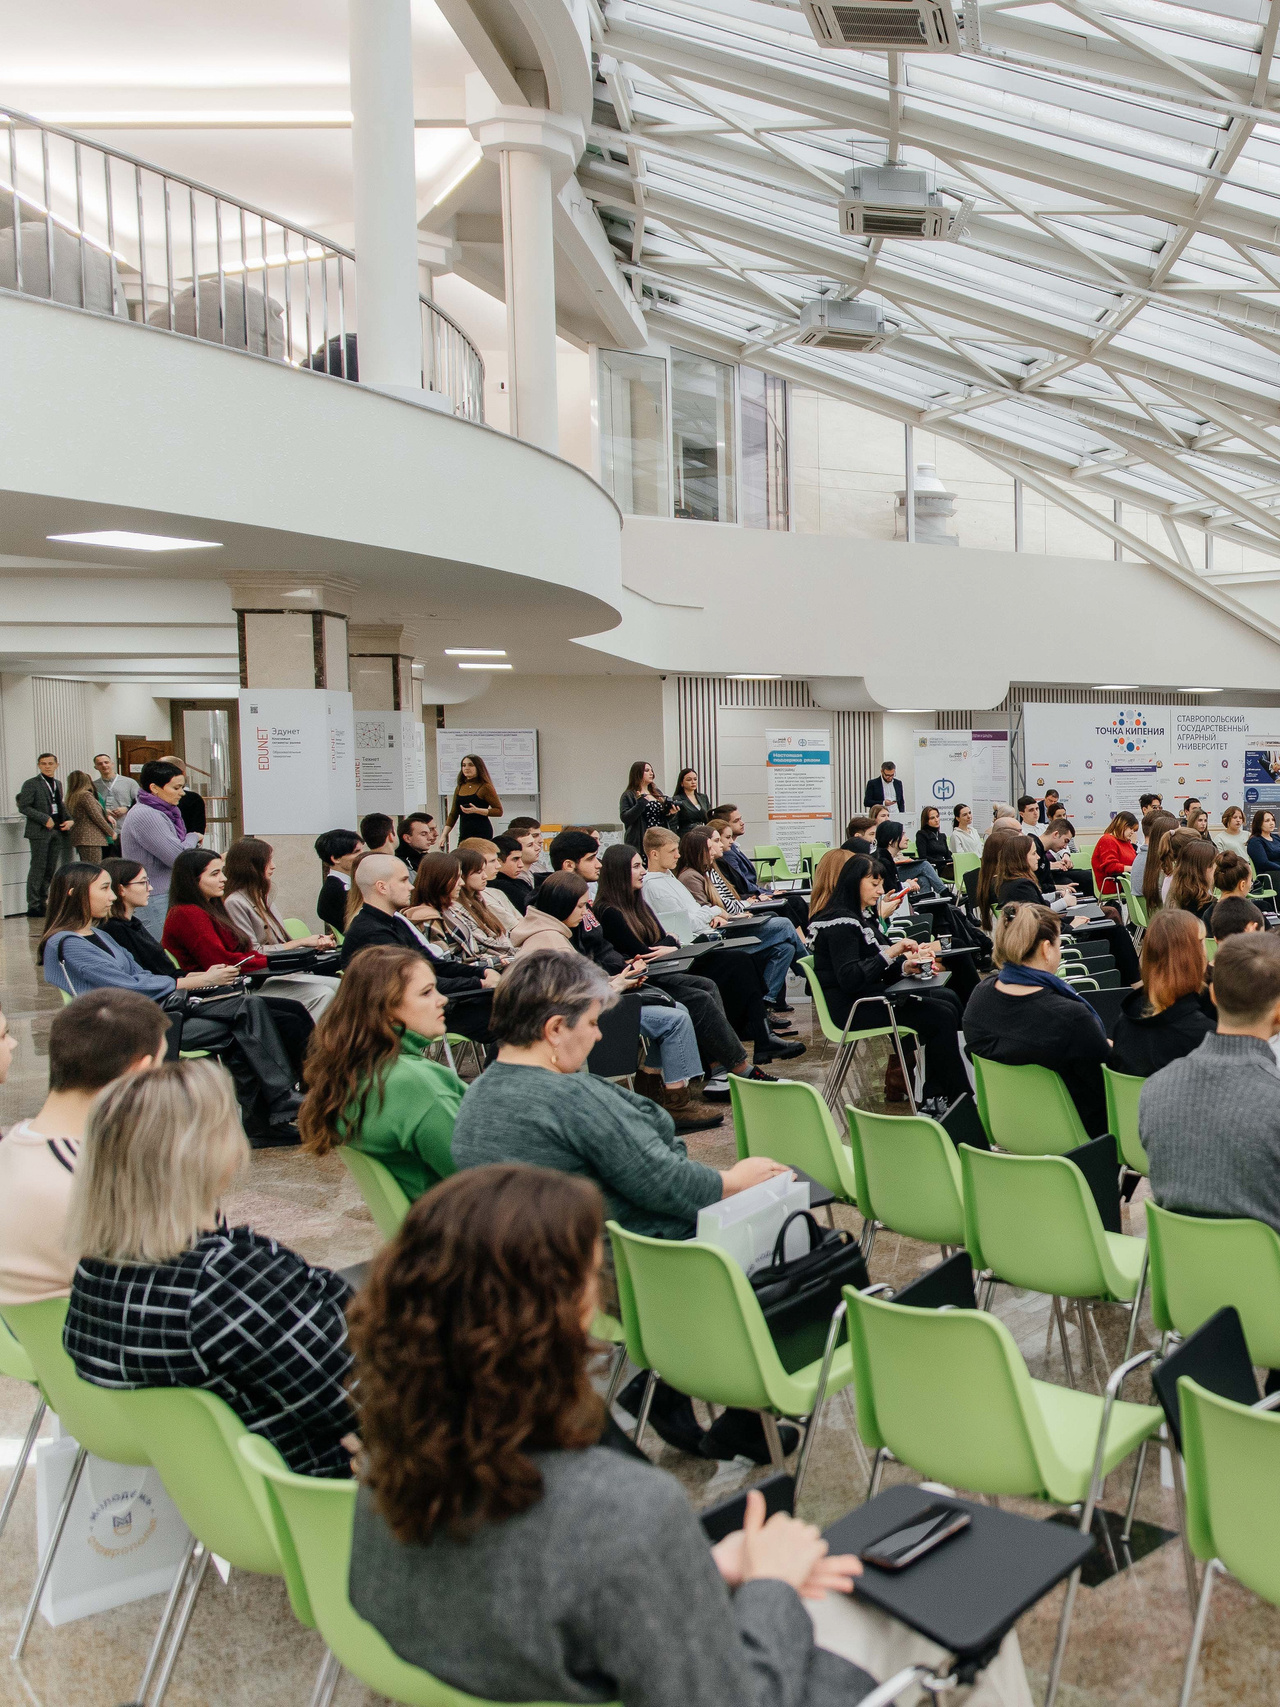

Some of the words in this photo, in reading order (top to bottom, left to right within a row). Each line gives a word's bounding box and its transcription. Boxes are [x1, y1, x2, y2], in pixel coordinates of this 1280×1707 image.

[1177, 714, 1245, 723] СТАВРОПОЛЬСКИЙ
[271, 727, 300, 736] Эдунет
[1095, 726, 1124, 736] ТОЧКА
[1125, 726, 1165, 736] КИПЕНИЯ
[1177, 723, 1250, 733] ГОСУДАРСТВЕННЫЙ
[1177, 732, 1217, 742] АГРАРНЫЙ
[257, 727, 270, 771] EDUNET
[1177, 742, 1228, 751] УНИВЕРСИТЕТ
